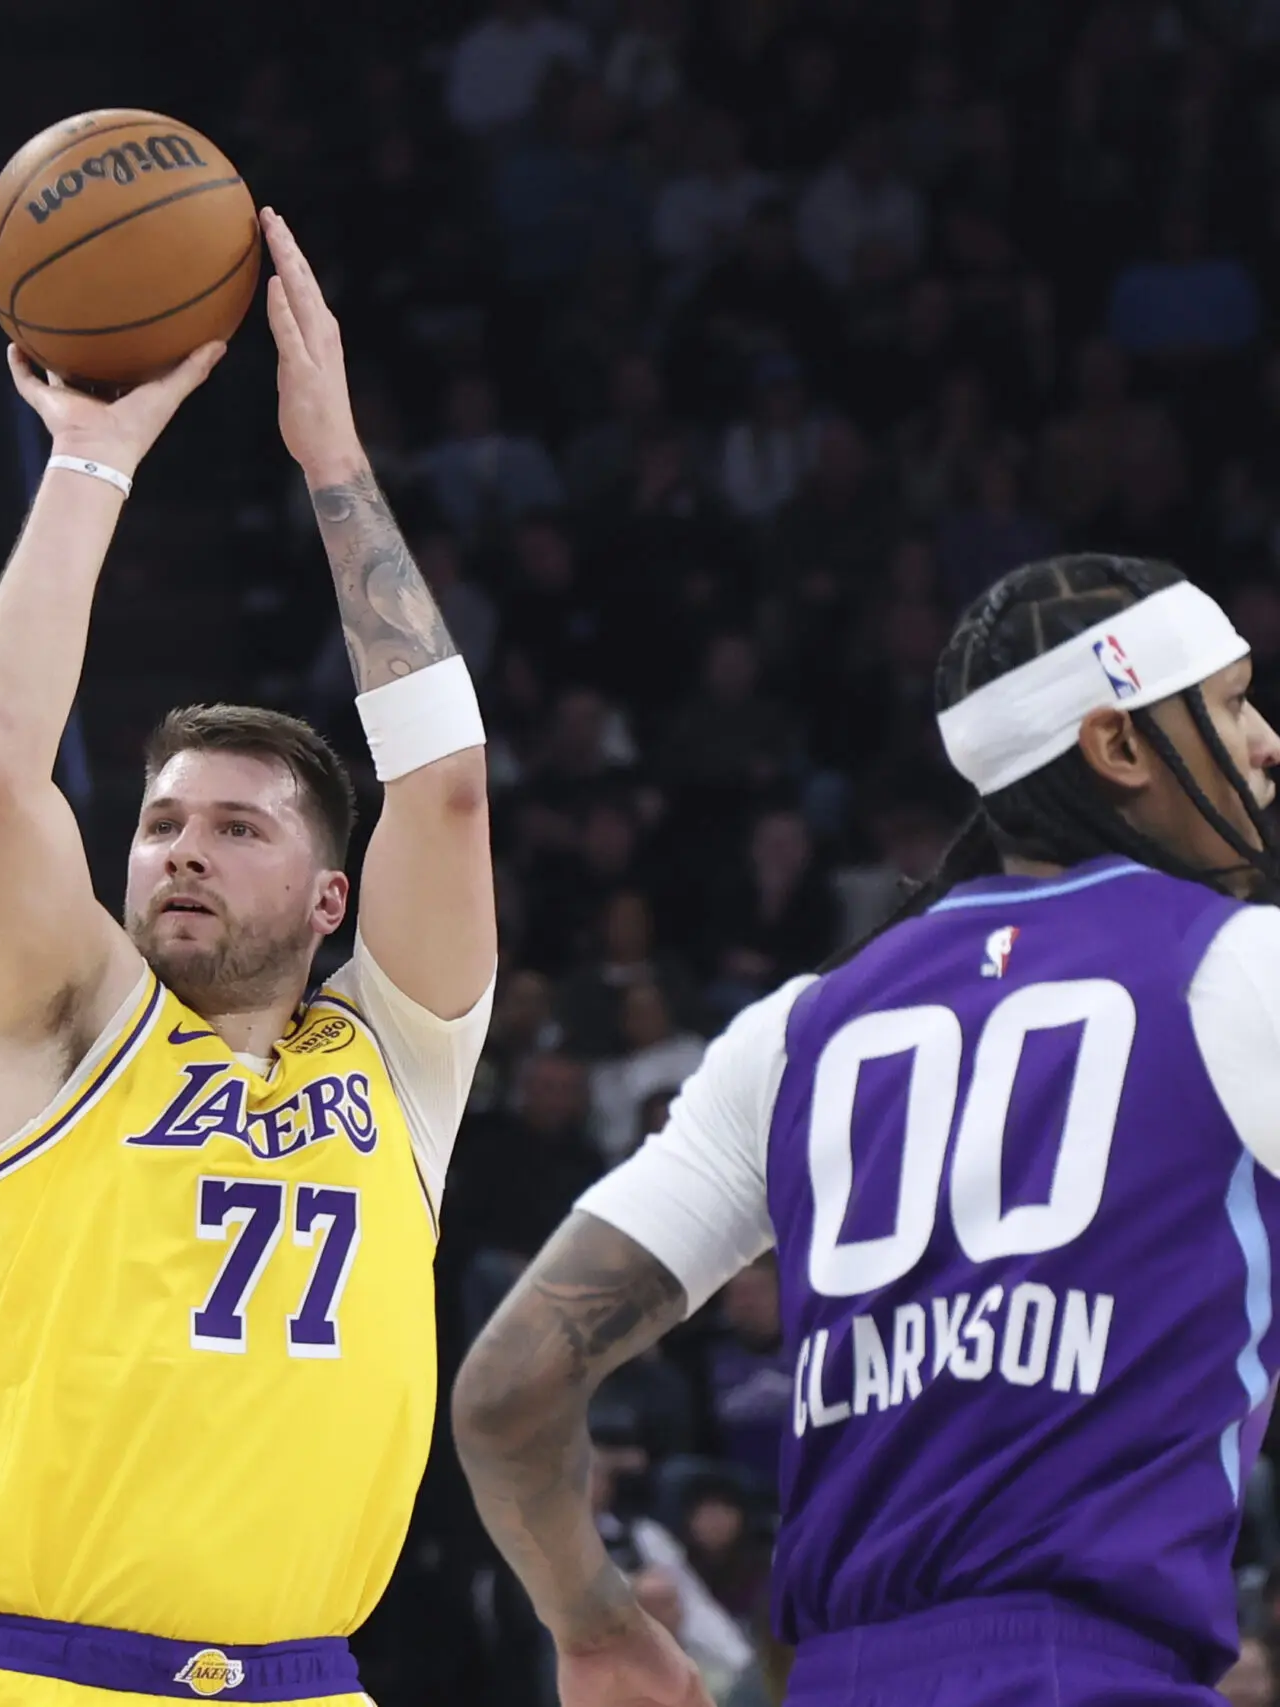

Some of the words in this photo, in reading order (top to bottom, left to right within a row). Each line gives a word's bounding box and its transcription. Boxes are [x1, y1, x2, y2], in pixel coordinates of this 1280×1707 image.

[25, 134, 208, 224] Wilson
[808, 978, 1137, 1298] 00
[190, 1175, 362, 1359] 77
[180, 1660, 242, 1686] LAKERS
